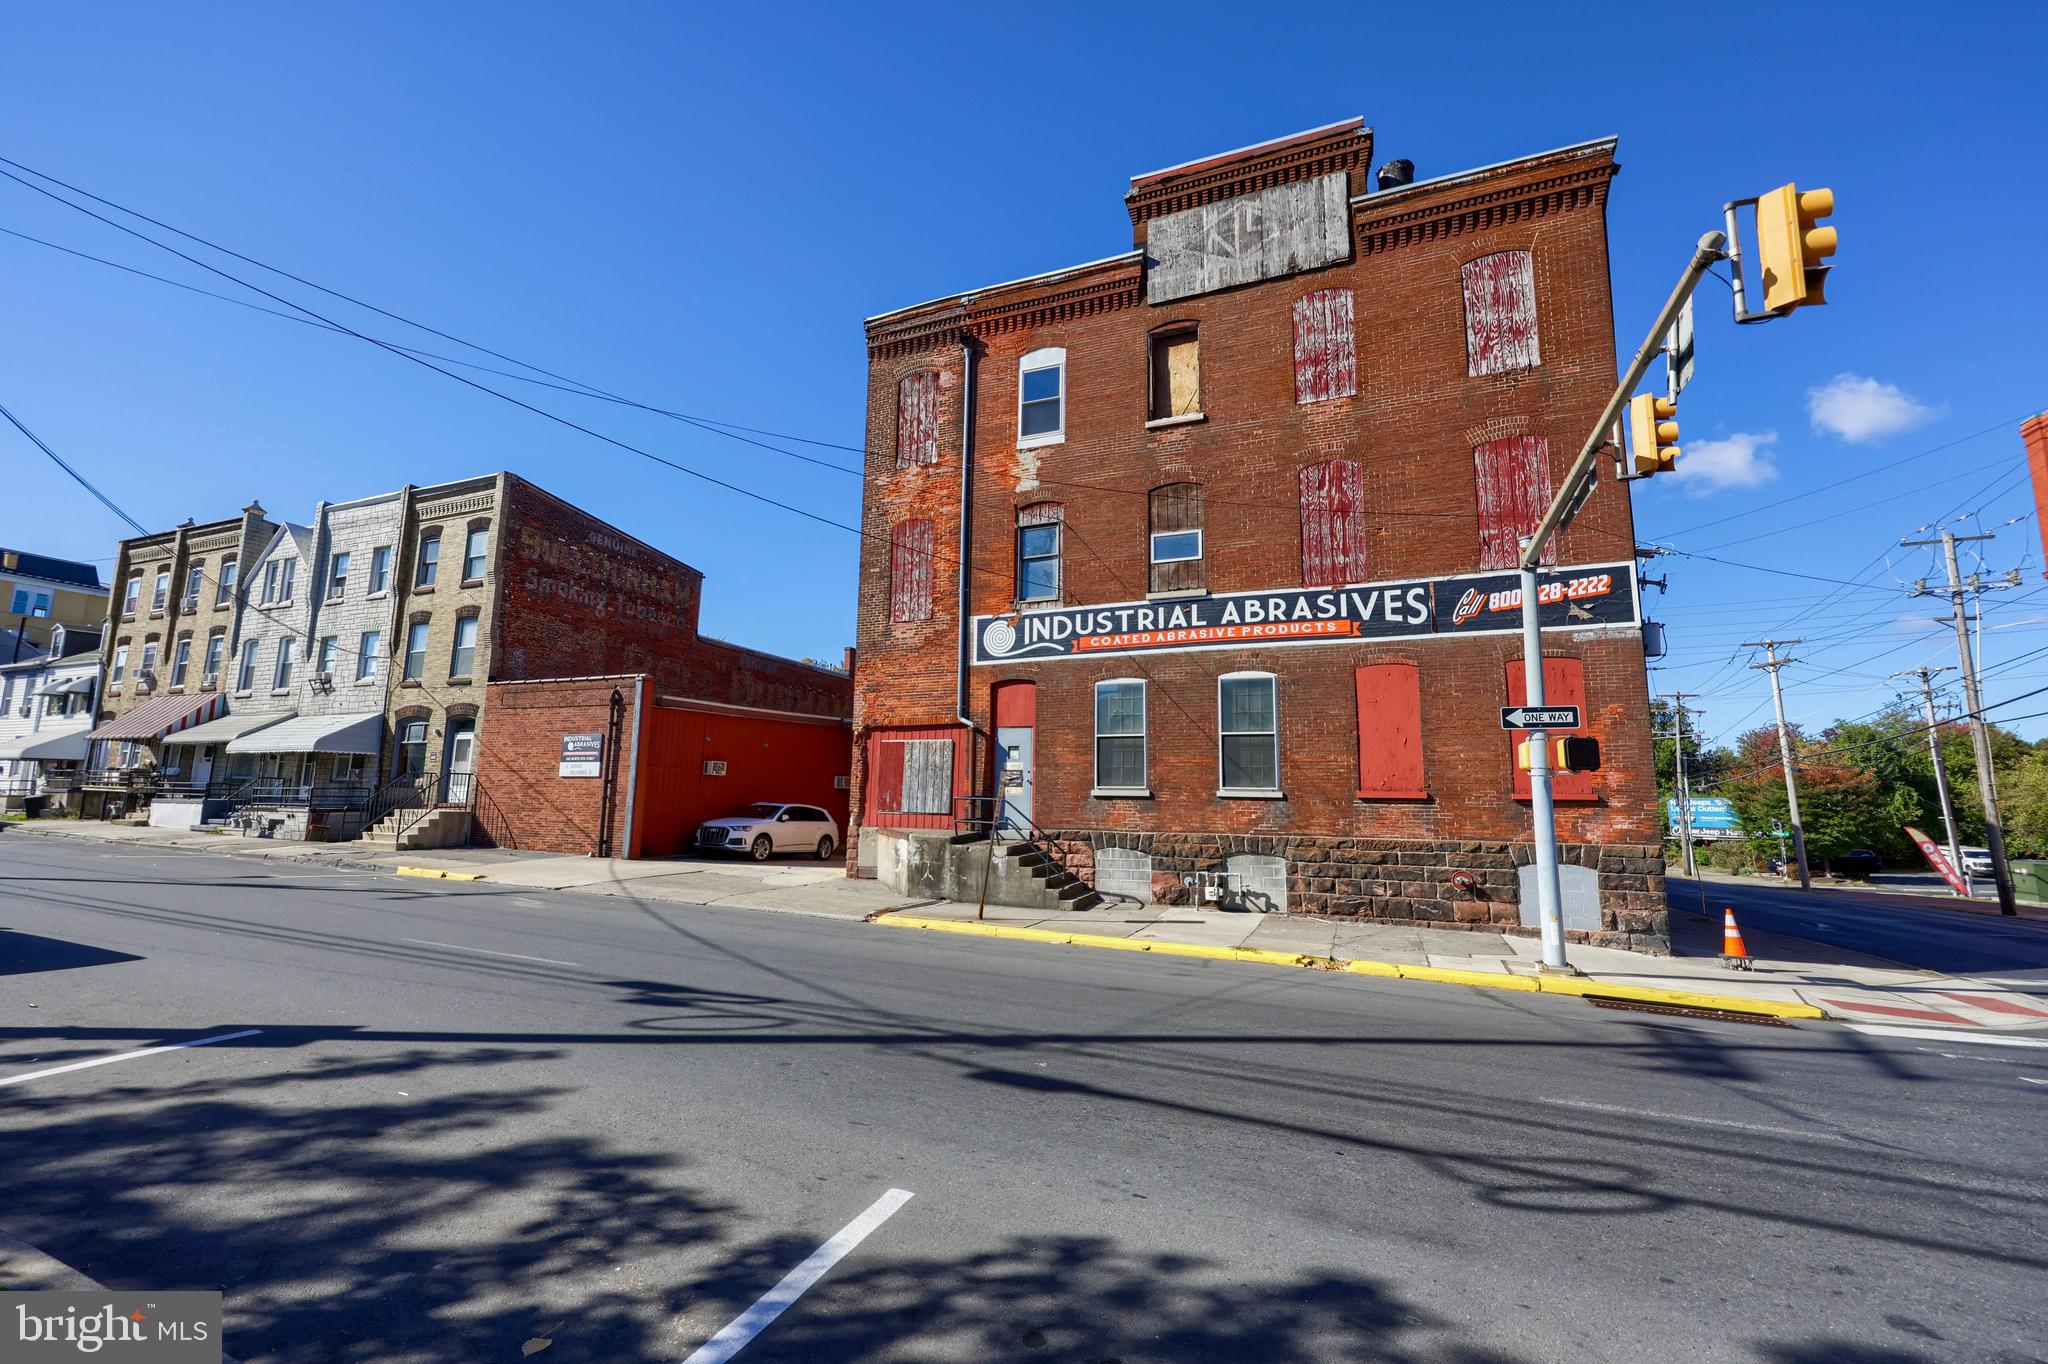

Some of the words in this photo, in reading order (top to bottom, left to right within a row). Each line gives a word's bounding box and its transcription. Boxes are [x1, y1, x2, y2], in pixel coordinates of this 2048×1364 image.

[1452, 588, 1487, 623] Call
[1489, 575, 1610, 609] 80028-2222
[1024, 604, 1207, 645] INDUSTRIAL
[1221, 587, 1428, 624] ABRASIVES
[1091, 634, 1151, 646] COATED
[1156, 628, 1238, 641] ABRASIVE
[1242, 622, 1336, 636] PRODUCTS
[1524, 713, 1544, 722] ONE
[1548, 713, 1570, 722] WAY
[564, 735, 592, 743] INDUSTRIAL
[574, 741, 600, 749] ABRASIVES
